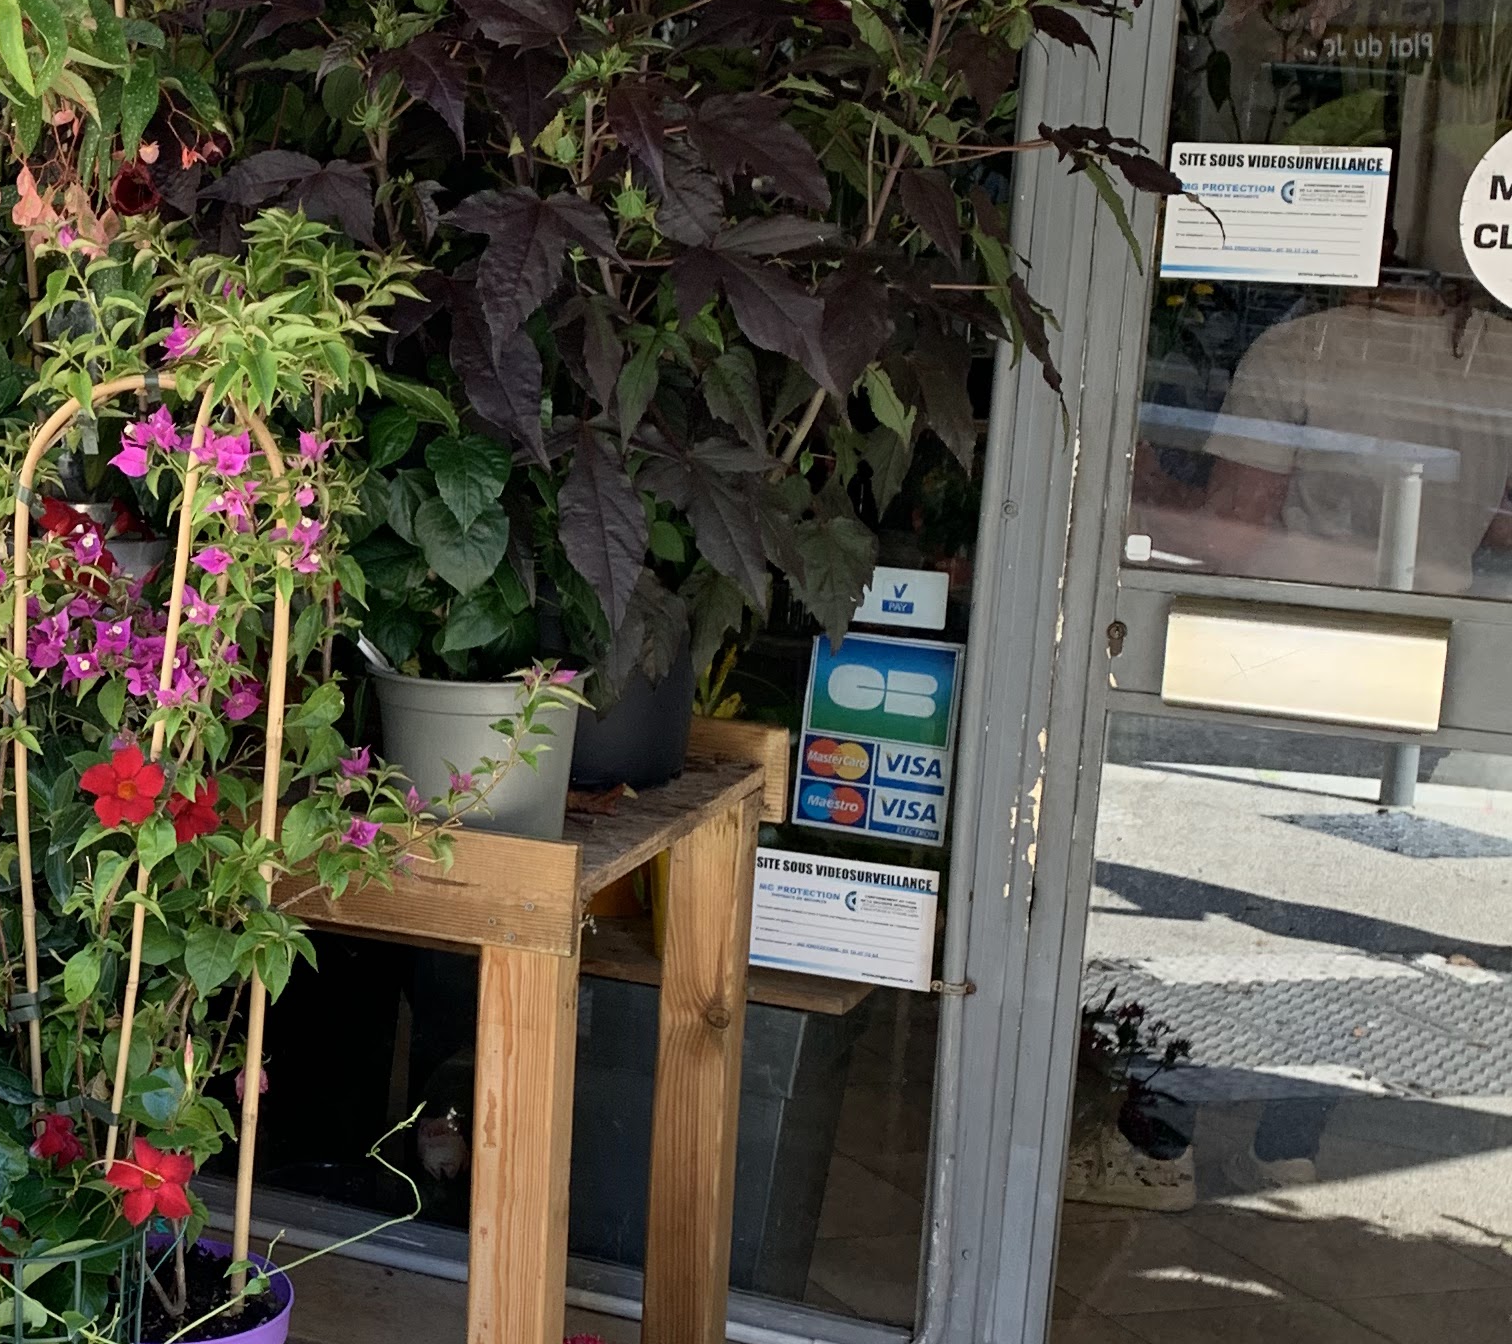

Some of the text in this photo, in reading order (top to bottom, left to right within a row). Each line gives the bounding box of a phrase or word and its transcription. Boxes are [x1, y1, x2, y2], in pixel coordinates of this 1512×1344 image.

[1179, 152, 1384, 172] SITE SOUS VIDEOSURVEILLANCE
[1202, 182, 1275, 194] PROTECTION
[888, 602, 908, 612] PAY
[807, 749, 870, 769] MasterCard
[886, 752, 942, 779] VISA
[807, 794, 859, 813] Maestro
[880, 795, 937, 824] VISA
[896, 826, 937, 839] ELECTRON
[757, 856, 933, 892] SITE SOUS VIDEOSURVEILLANCE
[777, 886, 841, 900] PROTECTION
